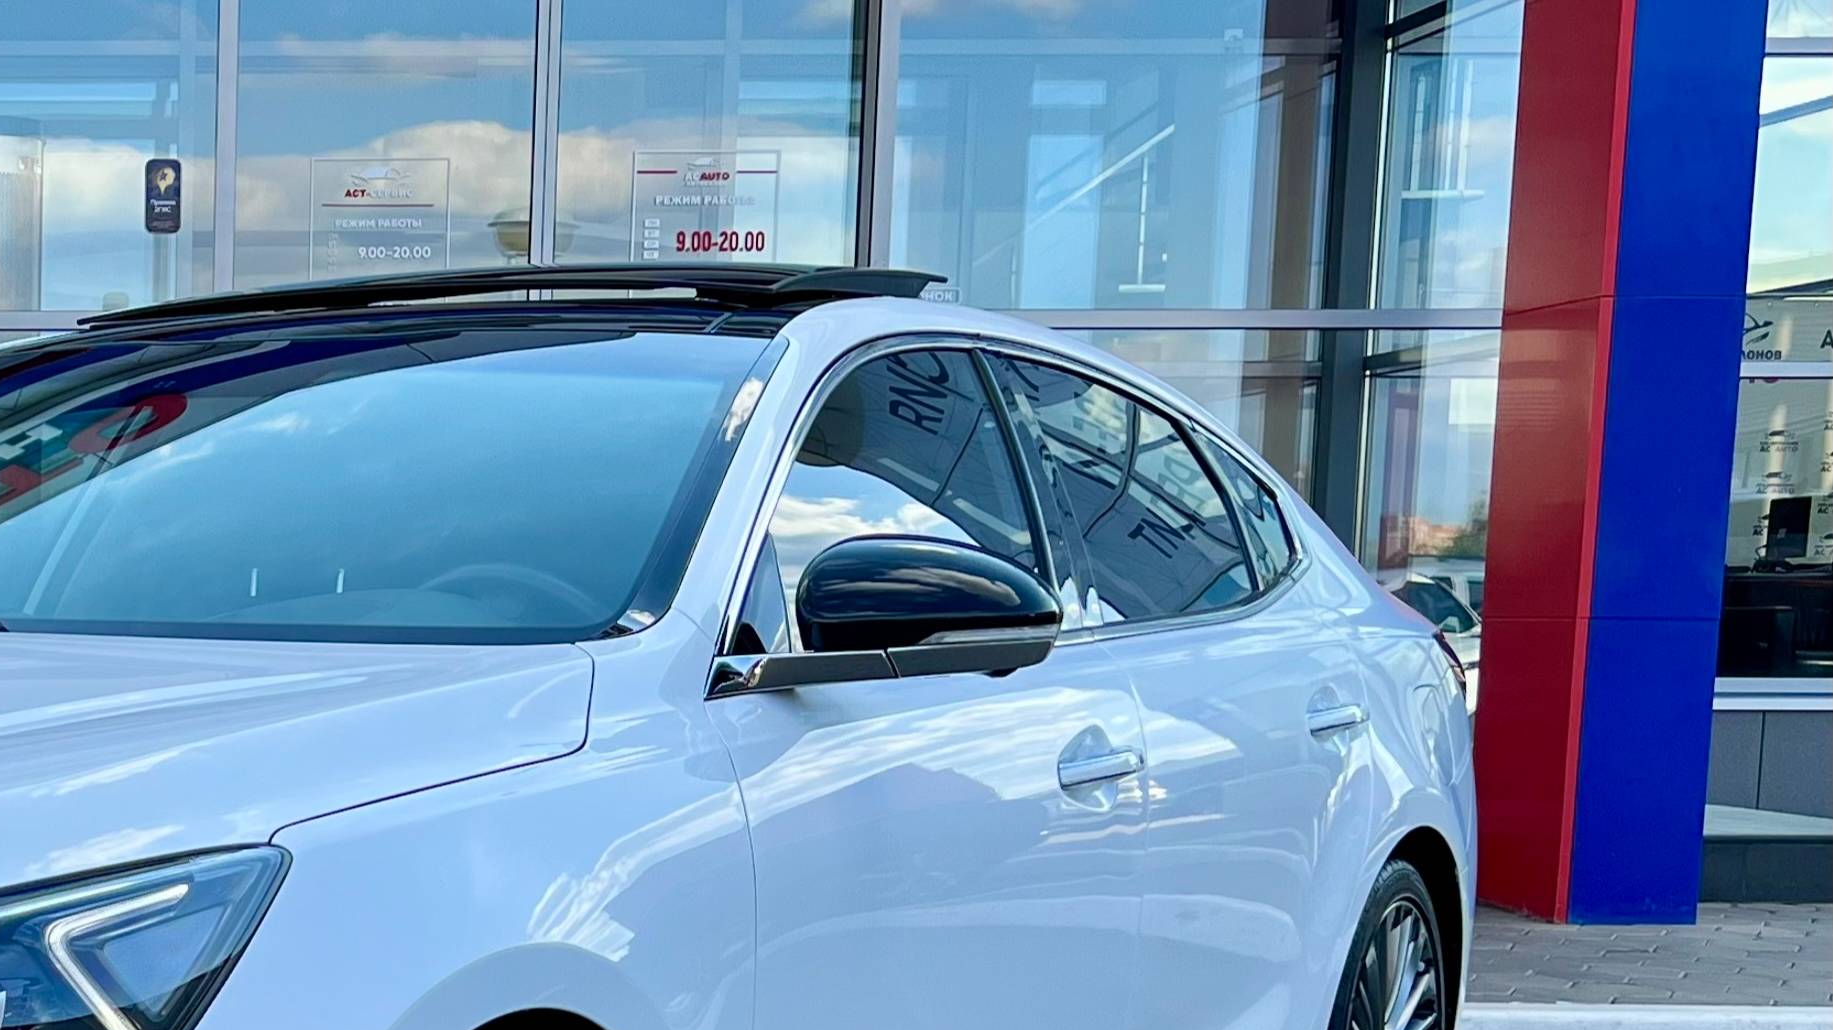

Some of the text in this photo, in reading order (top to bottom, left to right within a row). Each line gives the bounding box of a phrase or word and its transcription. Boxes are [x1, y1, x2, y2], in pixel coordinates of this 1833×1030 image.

[654, 195, 701, 206] РЕЖИМ
[335, 217, 423, 229] РЕЖИМ РАБОТЫ
[676, 231, 765, 252] 9.00-20.00
